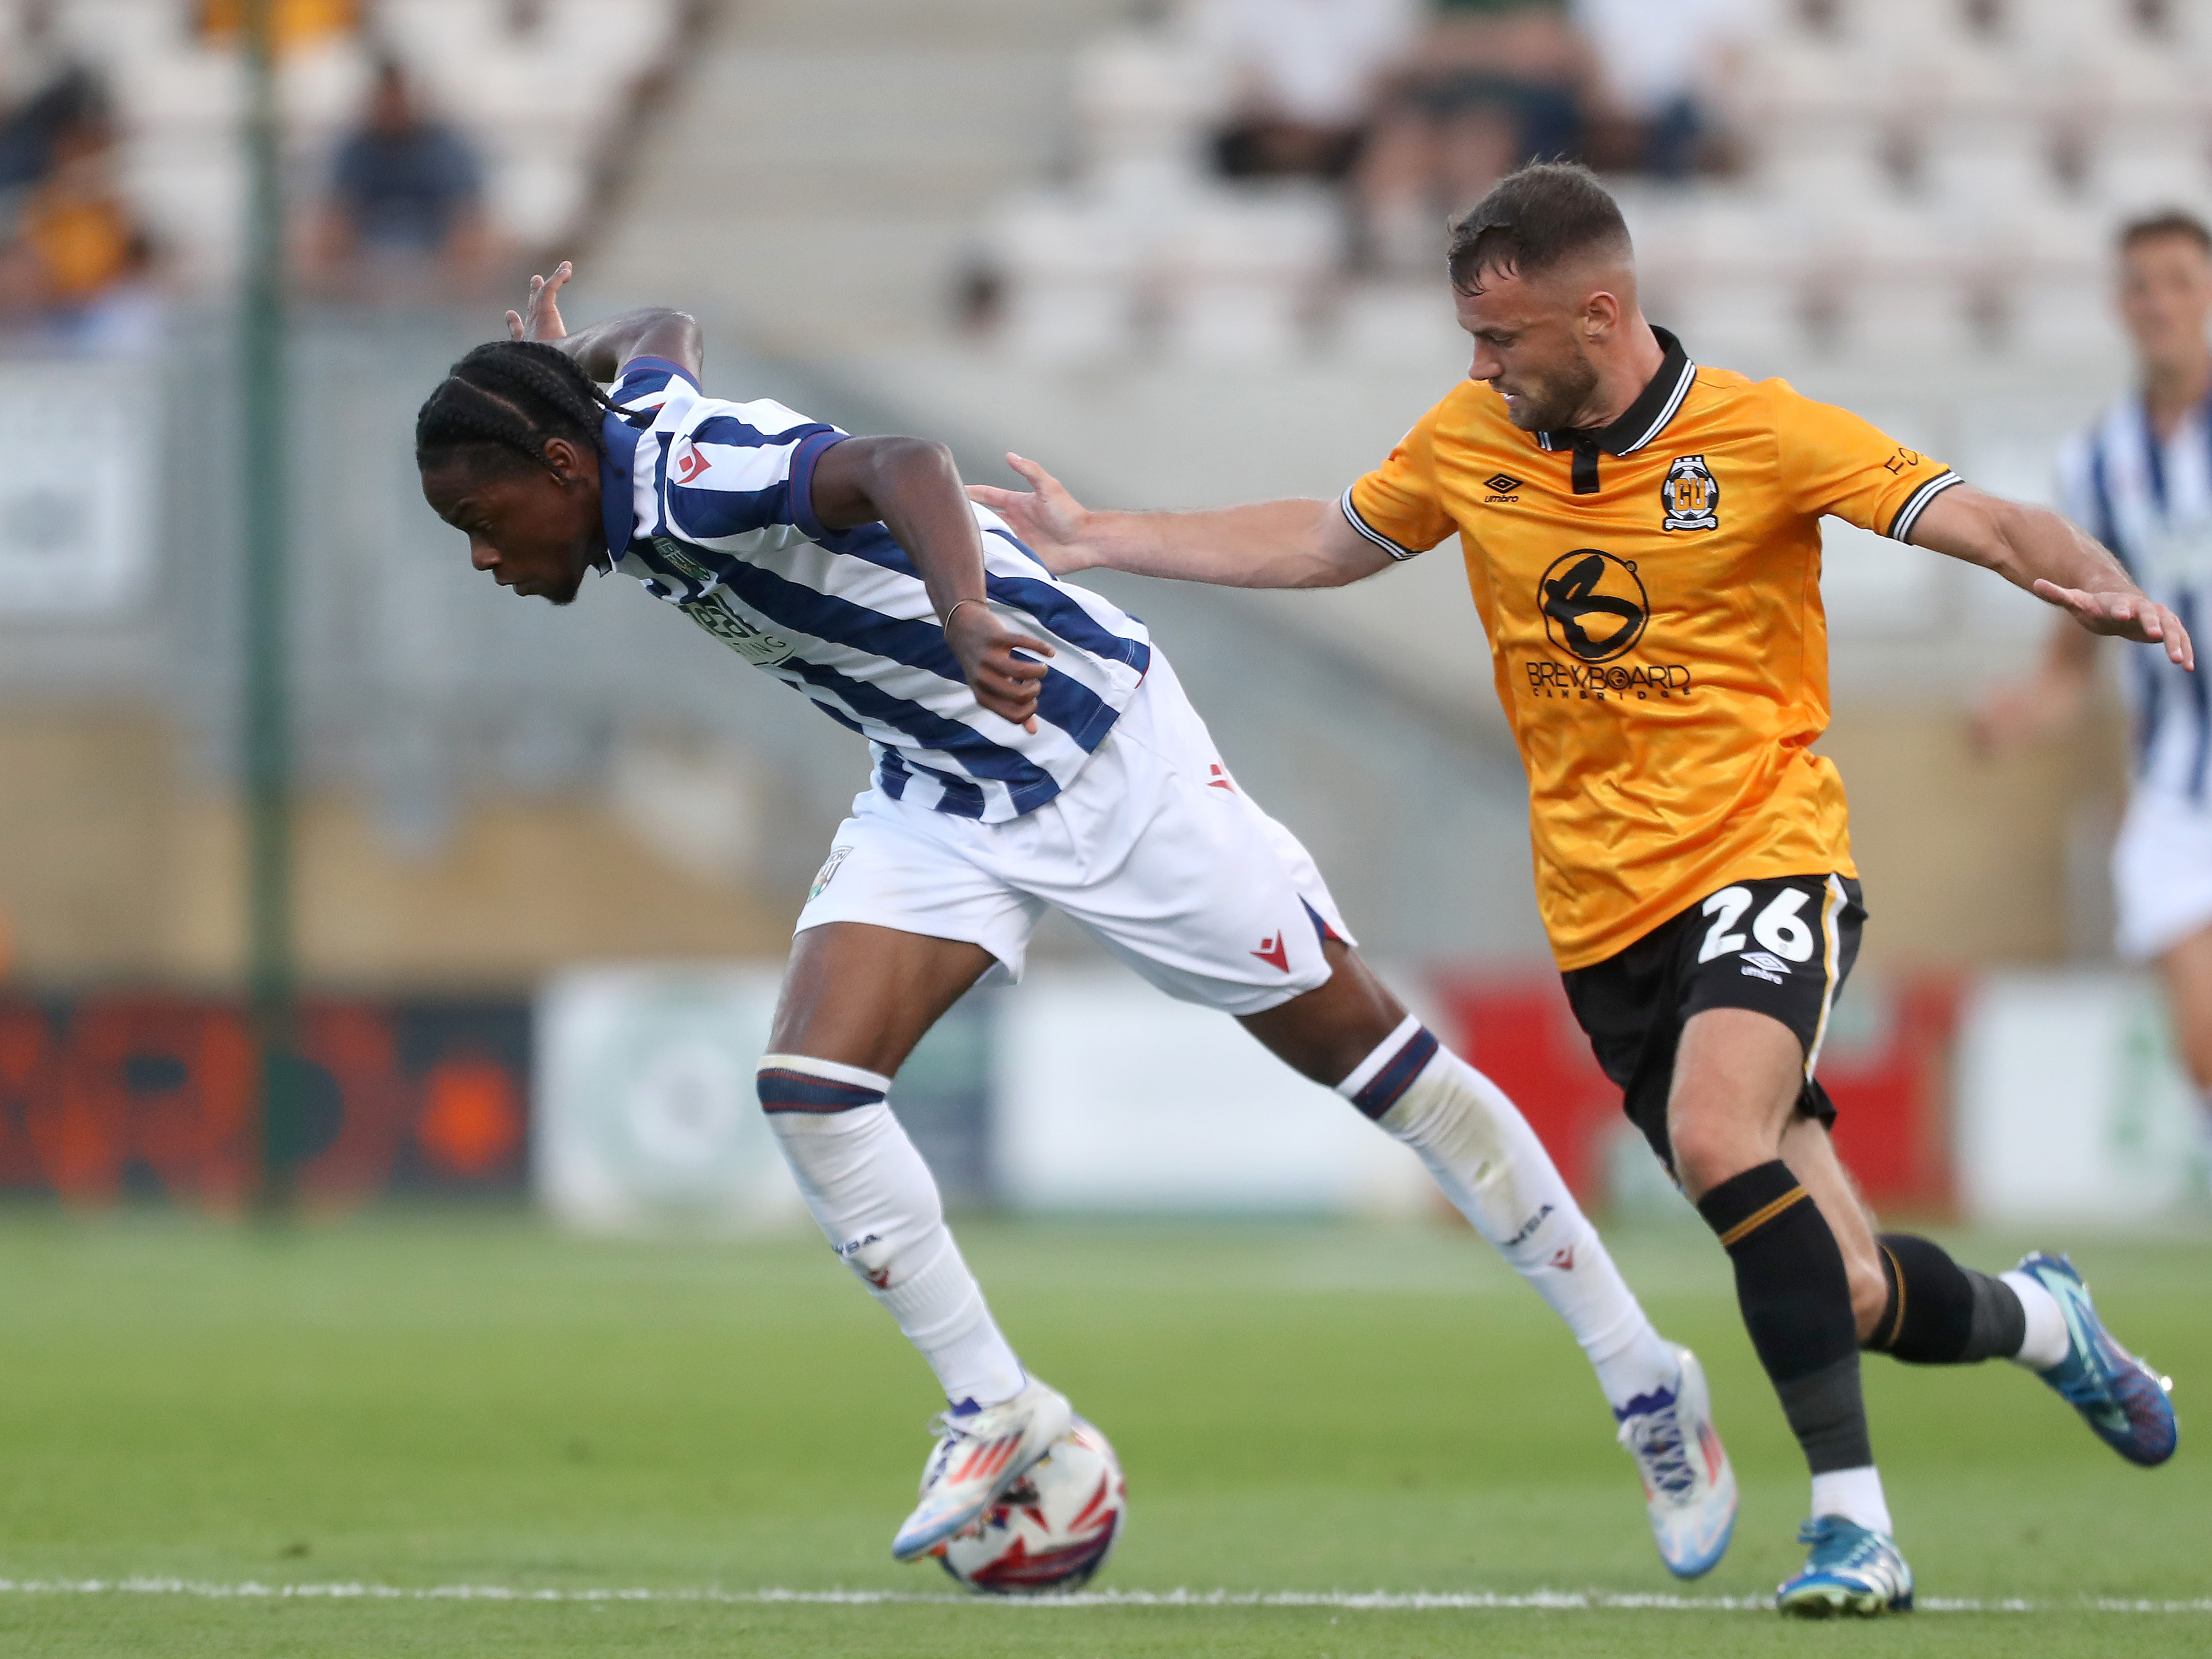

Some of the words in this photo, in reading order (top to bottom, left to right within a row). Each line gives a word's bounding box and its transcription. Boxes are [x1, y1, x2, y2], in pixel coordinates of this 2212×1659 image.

[1675, 477, 1706, 511] CU
[1533, 682, 1690, 701] CAMBRIDGE
[1698, 885, 1813, 964] 26
[1740, 965, 1783, 985] umbro
